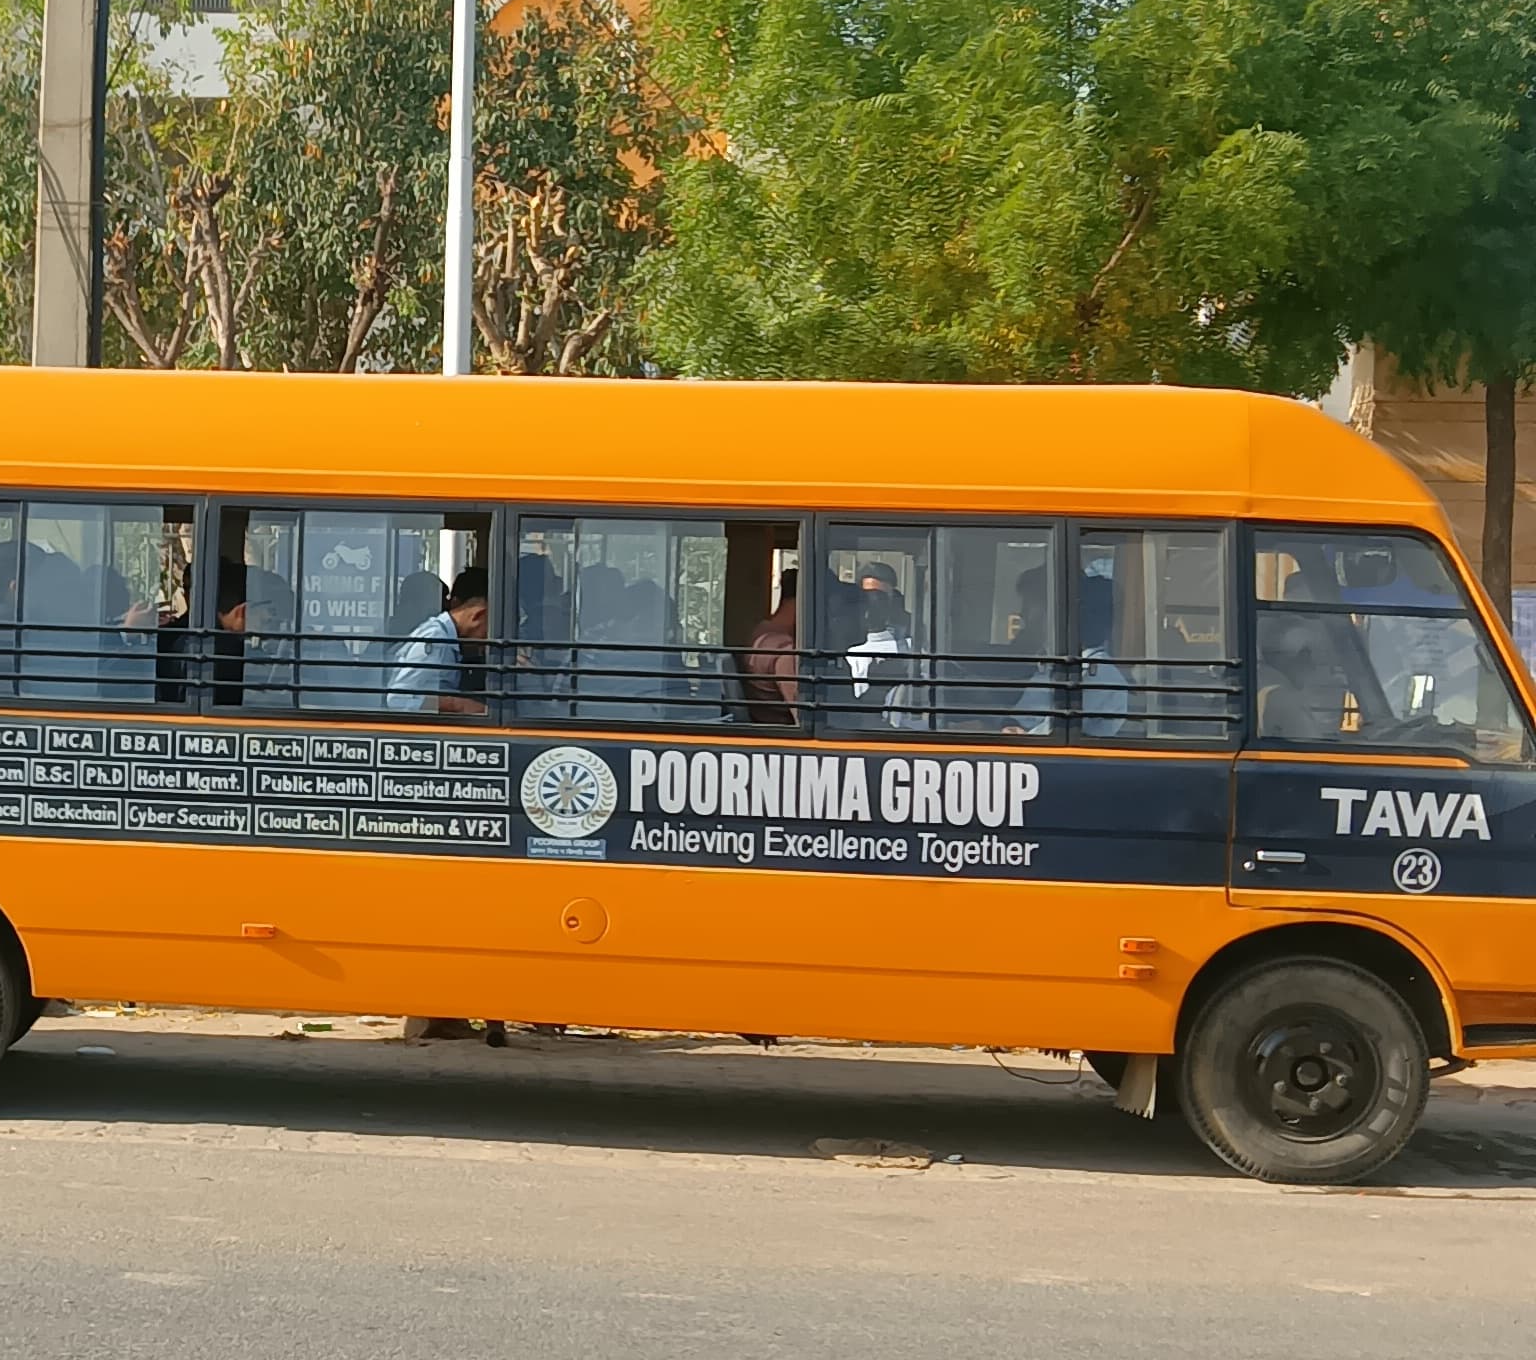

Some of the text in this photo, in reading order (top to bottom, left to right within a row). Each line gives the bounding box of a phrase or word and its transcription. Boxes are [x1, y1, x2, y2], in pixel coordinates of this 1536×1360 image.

[52, 731, 94, 750] MCA
[120, 734, 161, 752] BBA
[184, 737, 230, 755] MBA
[249, 739, 303, 758] B.Arch
[314, 742, 368, 760] M.Plan
[383, 744, 434, 763] B.Des
[447, 746, 500, 765] M.Des
[35, 765, 72, 783] B.Sc
[85, 767, 123, 785] Ph.D
[136, 769, 181, 788] Hotel
[186, 771, 241, 792] Mgmt.
[260, 774, 313, 793] Public
[315, 776, 369, 795] Health
[383, 779, 450, 801] Hospital
[452, 782, 506, 801] Admin.
[629, 748, 1040, 828] POORNIMA GROUP
[33, 801, 117, 823] Blockchain
[129, 805, 175, 827] Cyber
[176, 808, 247, 831] Security
[259, 811, 302, 830] Cloud
[304, 813, 340, 832] Tech
[356, 815, 445, 836] Animation
[448, 818, 461, 836] &
[465, 819, 503, 838] VFX
[1320, 787, 1492, 840] TAWA
[630, 820, 1040, 873] Achieving Excellence Together
[1400, 854, 1434, 886] 23
